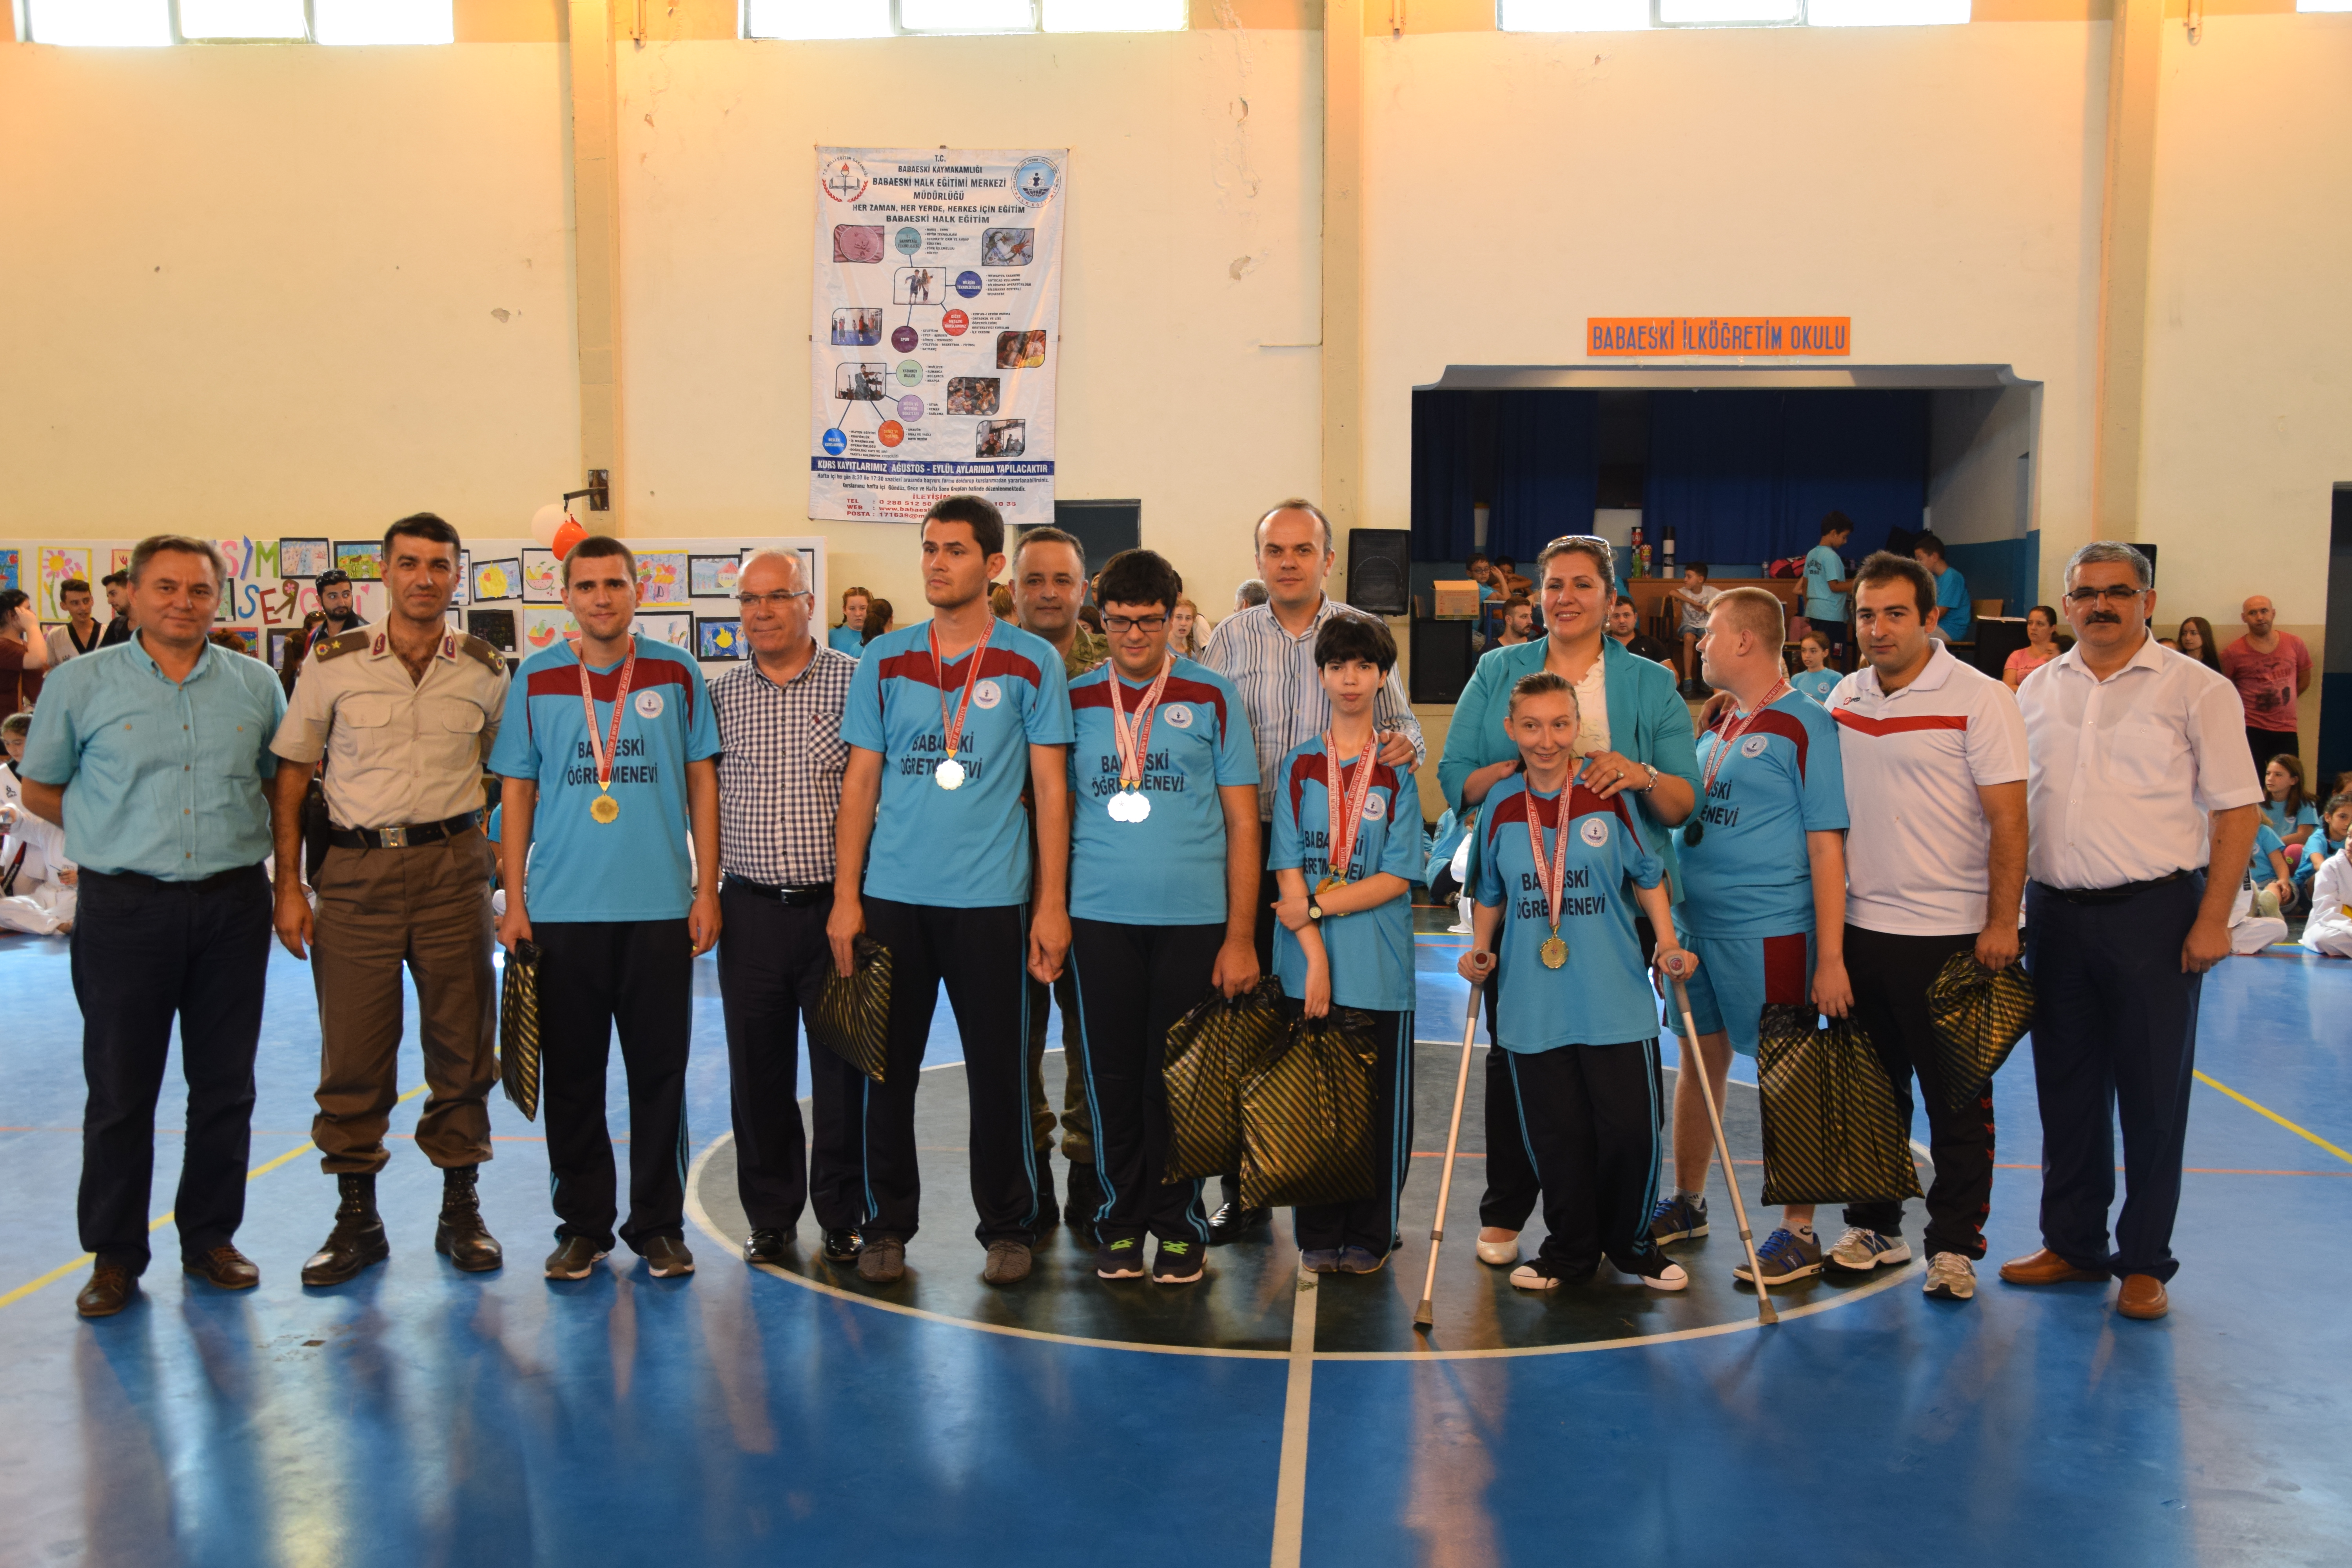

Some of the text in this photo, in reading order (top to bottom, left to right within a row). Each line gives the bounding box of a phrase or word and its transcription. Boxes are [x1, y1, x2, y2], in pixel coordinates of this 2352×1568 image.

[898, 165, 982, 174] BABAESKİ KAYMAKAMLIĞI
[873, 176, 1006, 187] BABAESKİ HALK EĞİTİMİ MERKEZİ
[913, 190, 964, 200] MÜDÜRLÜĞÜ
[886, 214, 929, 222] BABAESKİ
[958, 214, 989, 223] EĞİTİM
[980, 205, 995, 214] İÇİN
[999, 205, 1025, 213] EĞİTİM
[1593, 319, 1845, 350] BABAESKİ İLKÖĞRETİM OKULU
[818, 460, 1047, 474] KURS KAYITLARIMIZ AĞUSTOS EYLÜL AYLARINDA YAPILACAKTIR
[578, 735, 644, 759] BAESKİ
[912, 731, 974, 753] BABAKİ
[1102, 748, 1169, 773] BASKİ
[568, 762, 658, 786] ÖĞREMENEVİ
[1521, 866, 1588, 891] BASKİ
[1517, 893, 1605, 919] ÖĞREMENEVİ
